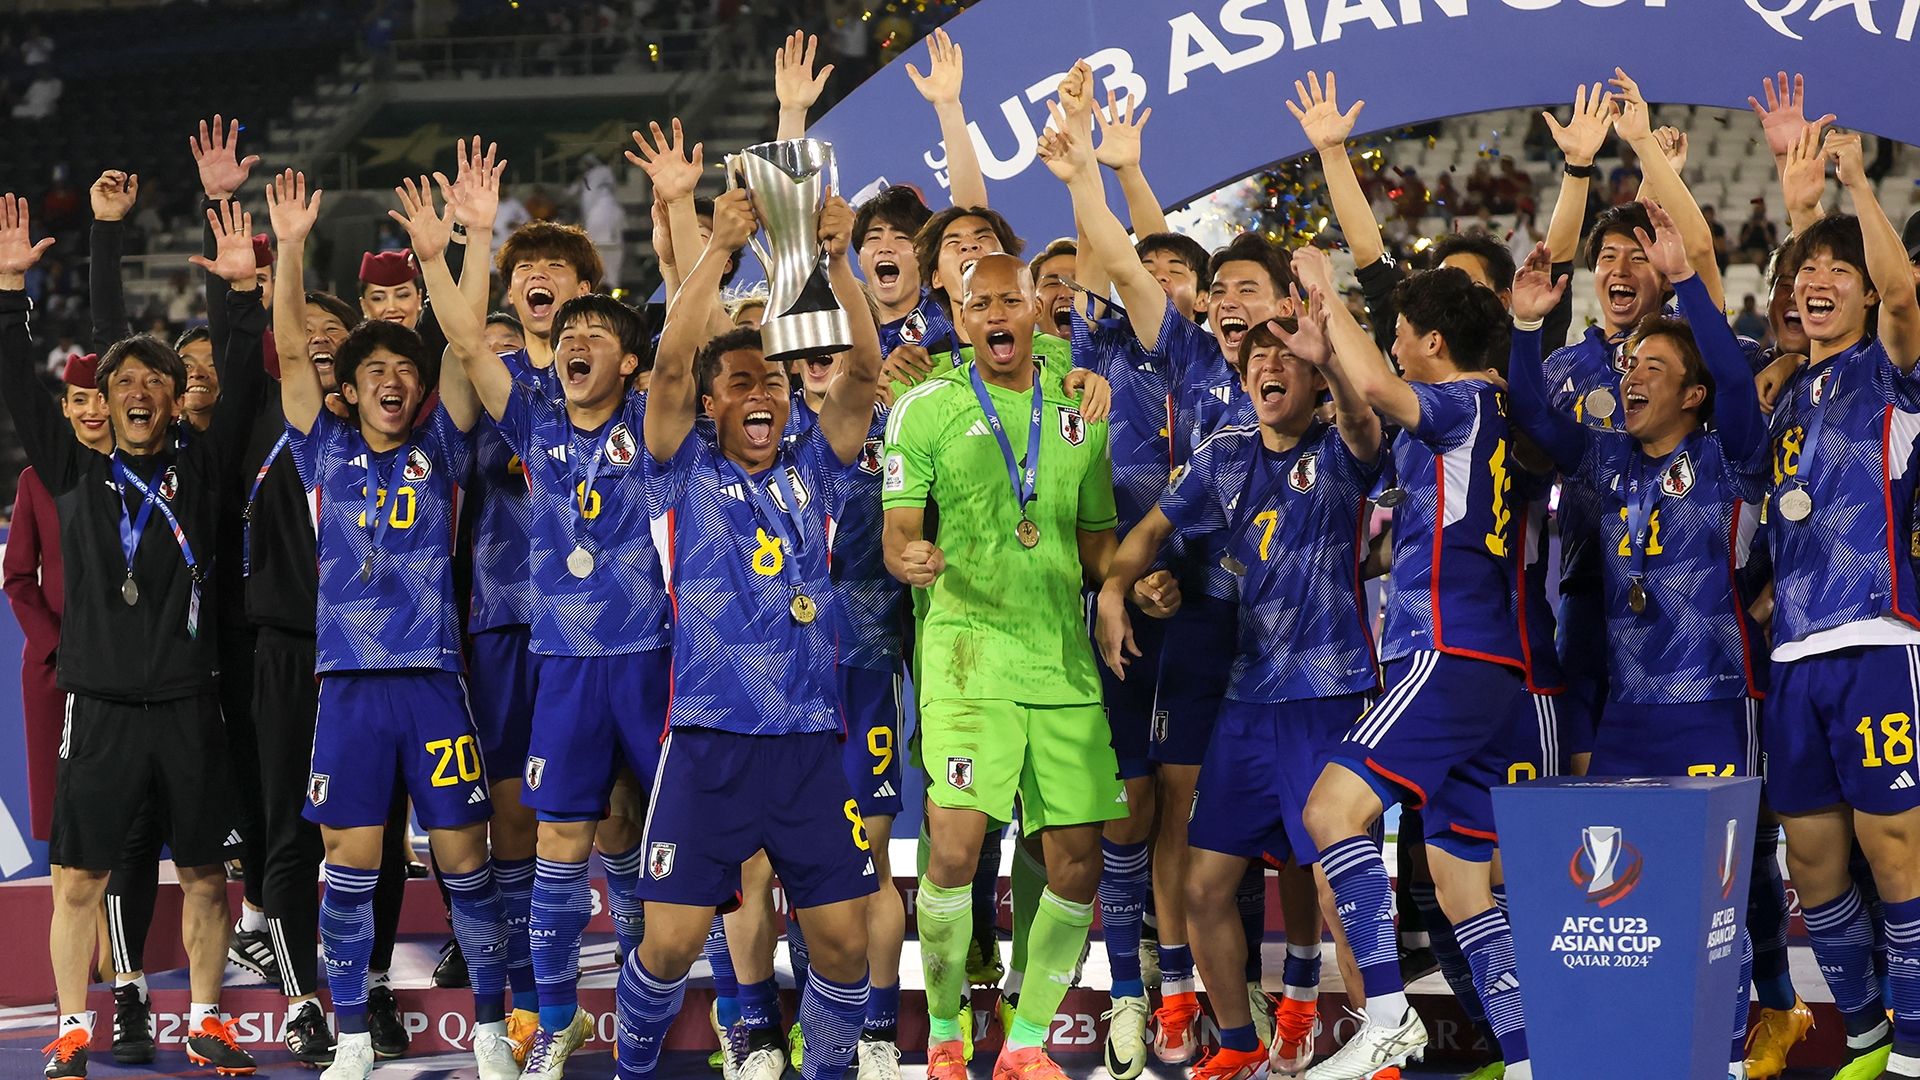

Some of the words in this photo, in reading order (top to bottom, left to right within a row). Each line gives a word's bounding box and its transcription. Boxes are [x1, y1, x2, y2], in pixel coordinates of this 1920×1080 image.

[987, 414, 1001, 431] AFC
[1032, 408, 1041, 427] AFC
[1026, 468, 1035, 487] AFC
[576, 480, 601, 519] 6
[1254, 510, 1278, 561] 7
[752, 528, 783, 576] 8
[867, 726, 893, 775] 9
[1855, 712, 1914, 767] 18
[425, 735, 481, 787] 20
[843, 799, 869, 851] 8
[1561, 916, 1605, 934] AFC
[1608, 917, 1648, 934] U23
[1711, 909, 1724, 930] AFC
[1723, 906, 1735, 925] U23
[529, 928, 557, 937] PAN
[1550, 935, 1615, 952] ASIAN
[1617, 936, 1662, 952] CUP
[1706, 928, 1724, 949] ASIAN
[1724, 923, 1737, 943] CUP
[1563, 954, 1610, 970] QATAR
[1613, 954, 1649, 968] 2024
[1044, 1013, 1097, 1045] 23
